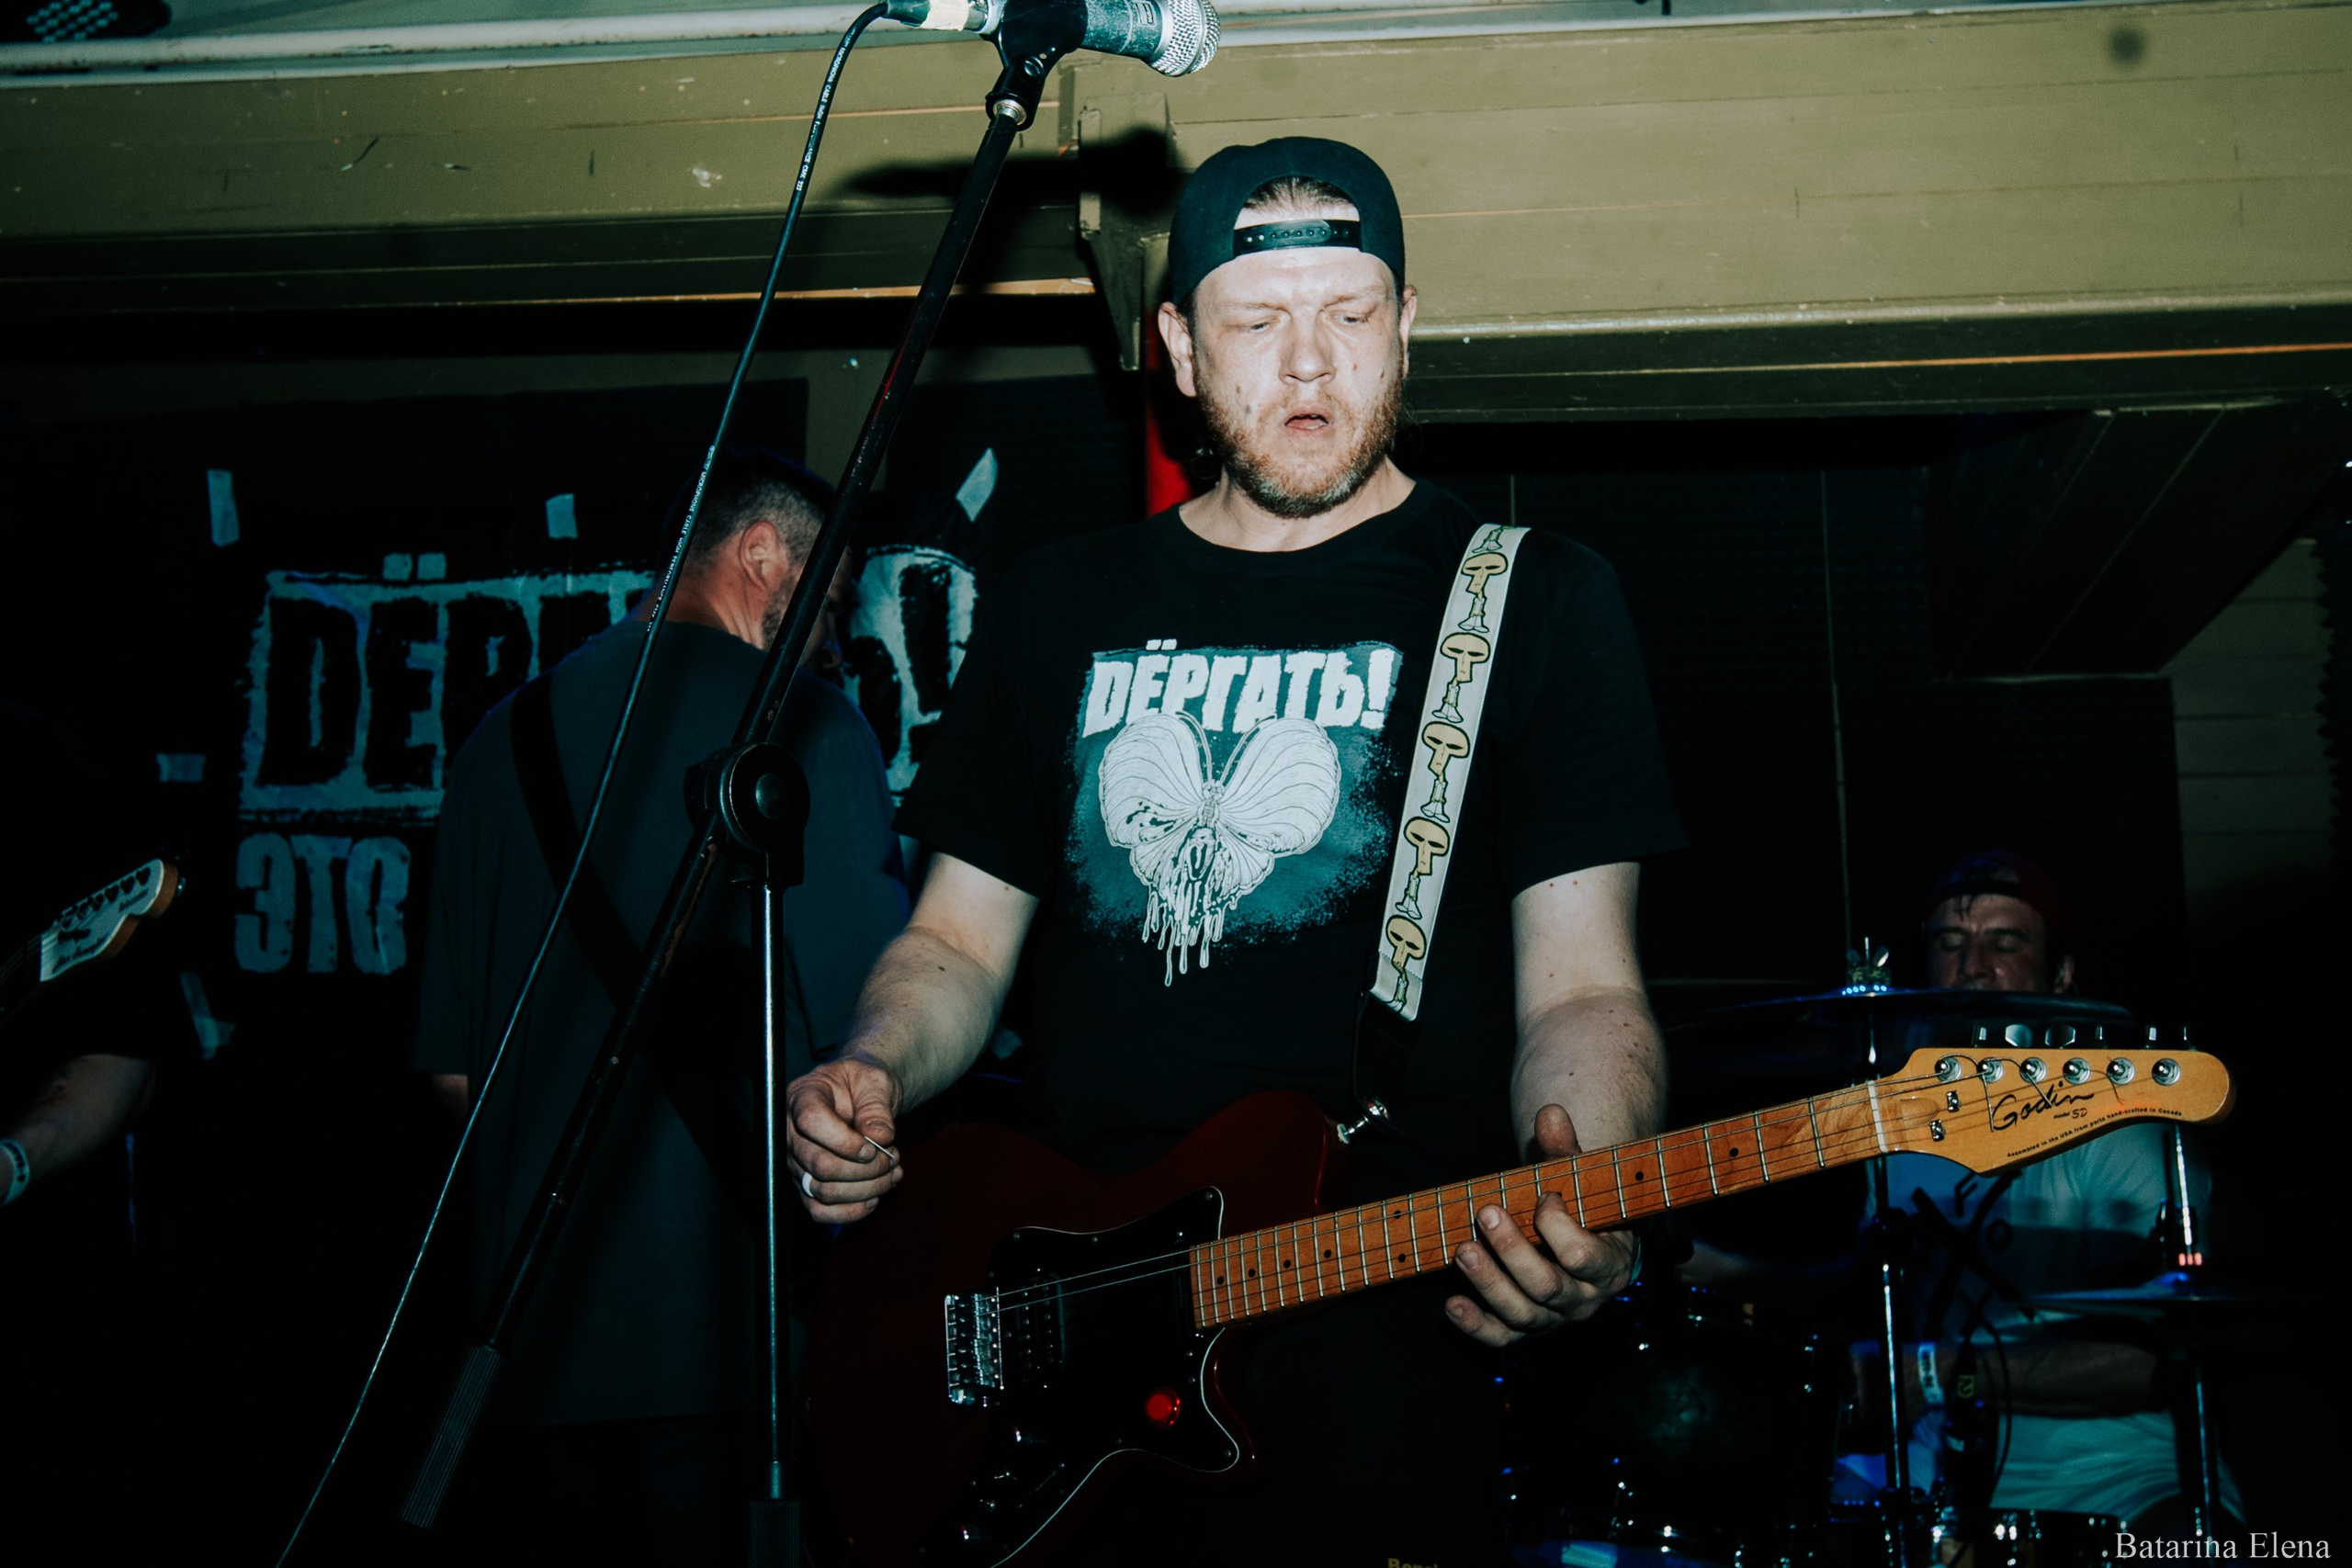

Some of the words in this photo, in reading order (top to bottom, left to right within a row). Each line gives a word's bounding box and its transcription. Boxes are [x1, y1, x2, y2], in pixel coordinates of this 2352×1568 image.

[1991, 1080, 2095, 1131] Godin
[2072, 1107, 2088, 1120] SD
[2007, 1143, 2040, 1157] Assembled
[2060, 1130, 2073, 1138] USA
[2074, 1123, 2088, 1134] from
[2089, 1117, 2106, 1127] parts
[2158, 1108, 2183, 1116] Canada
